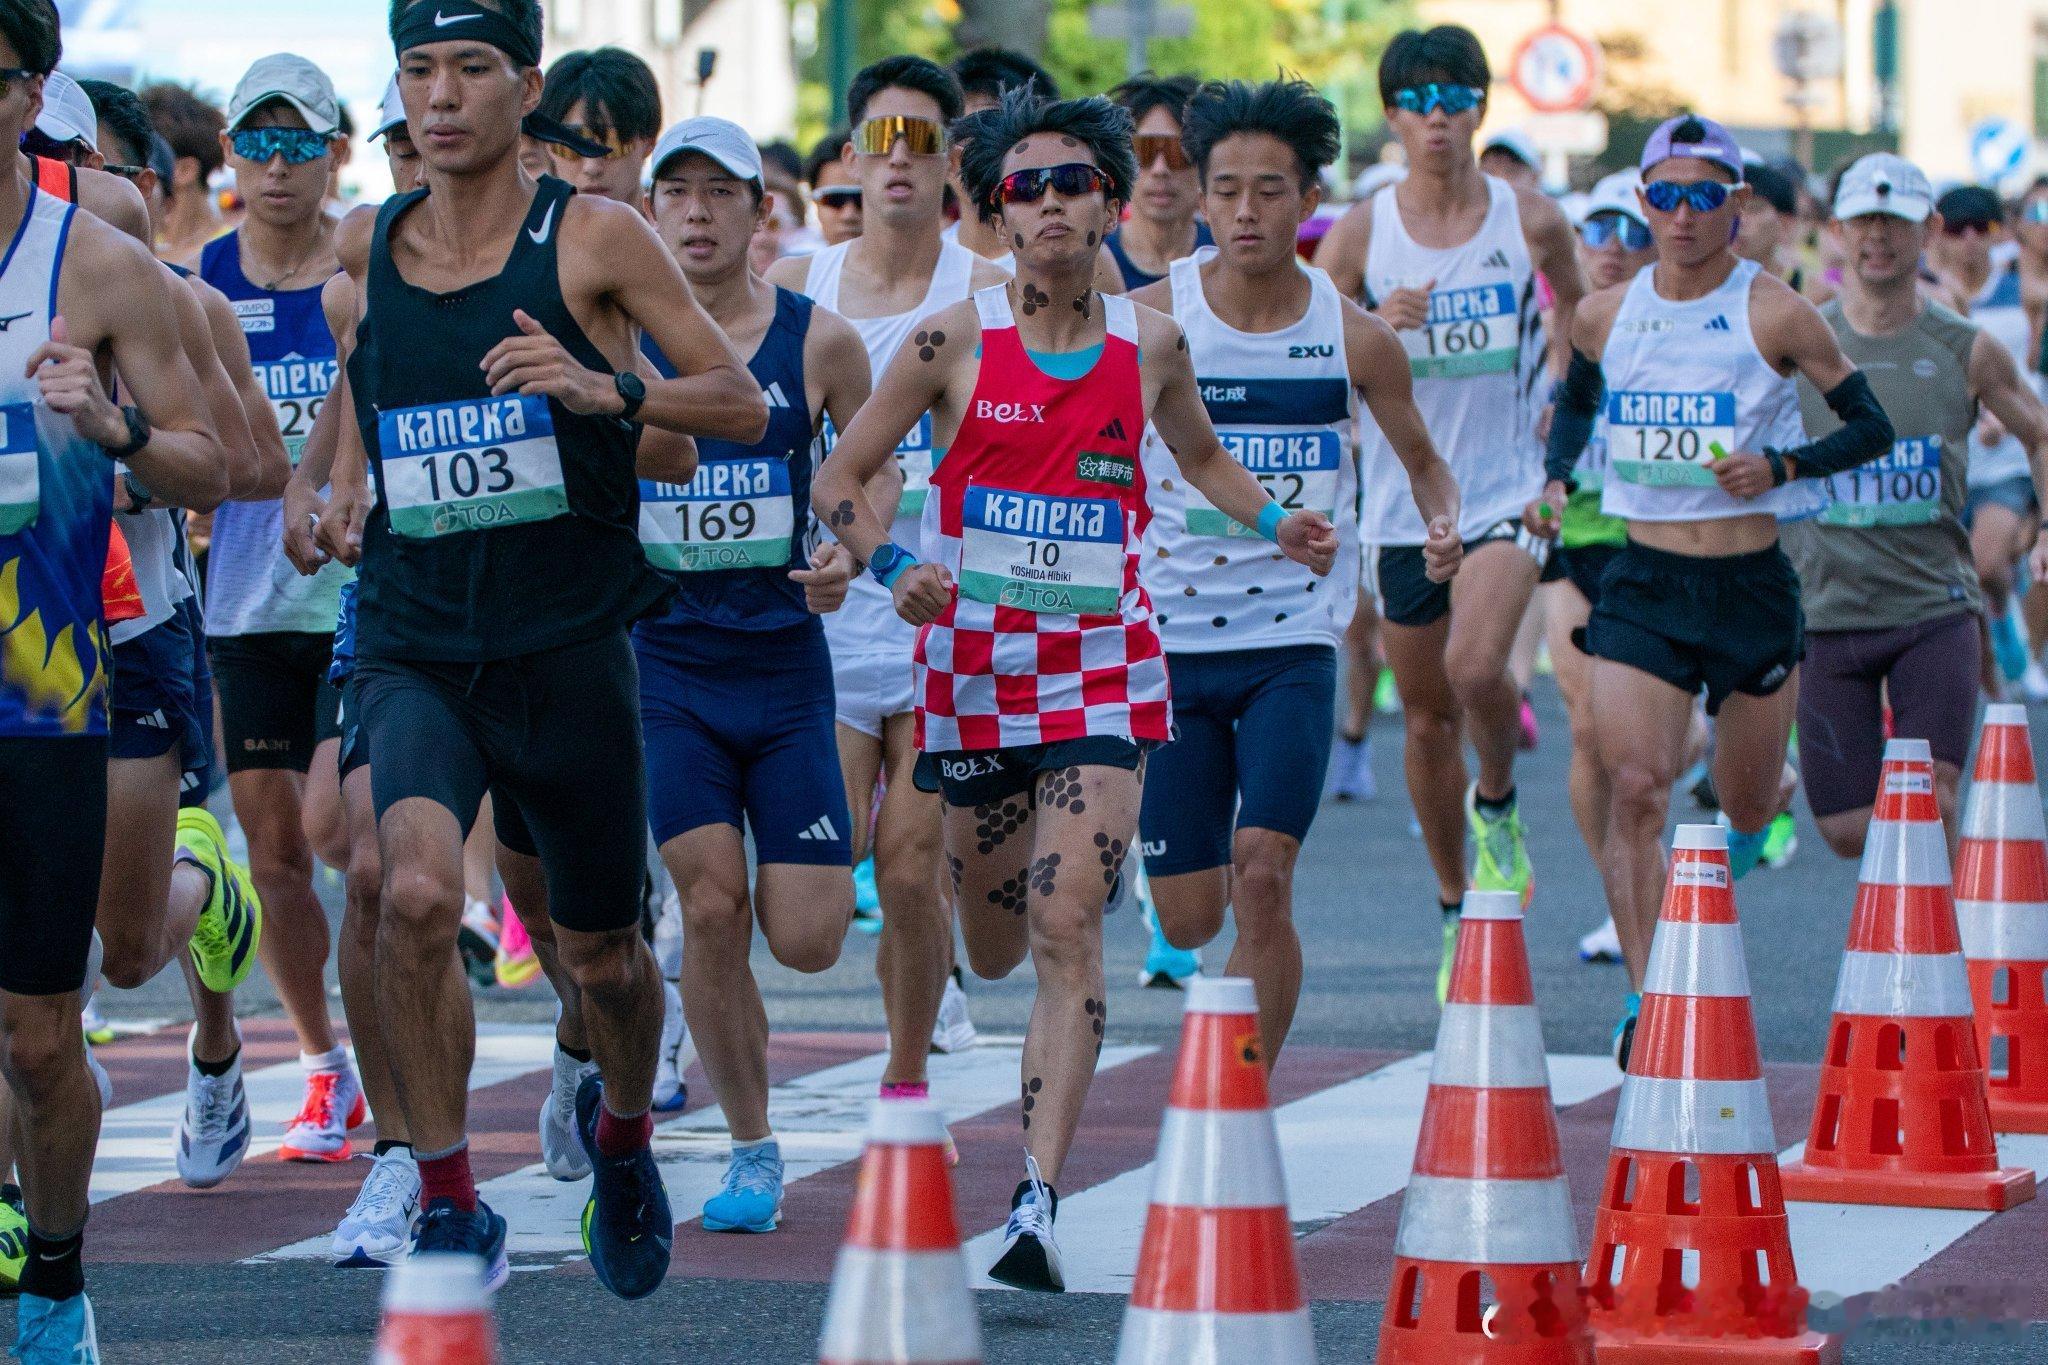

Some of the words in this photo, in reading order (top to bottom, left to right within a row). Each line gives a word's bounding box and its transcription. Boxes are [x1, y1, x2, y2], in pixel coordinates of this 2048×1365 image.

[1423, 320, 1490, 356] 160
[1288, 345, 1335, 359] 2XU
[1201, 385, 1247, 402] 化成
[1635, 426, 1700, 461] 120
[421, 447, 515, 501] 103
[1098, 459, 1134, 481] 裾野市
[459, 501, 518, 526] TOA
[674, 500, 757, 542] 169
[703, 544, 752, 566] TOA
[1027, 540, 1060, 567] 10
[1010, 564, 1046, 581] YOSHIDA
[1047, 570, 1072, 583] Hibiki
[1027, 587, 1073, 609] TOA
[1141, 839, 1167, 857] XU
